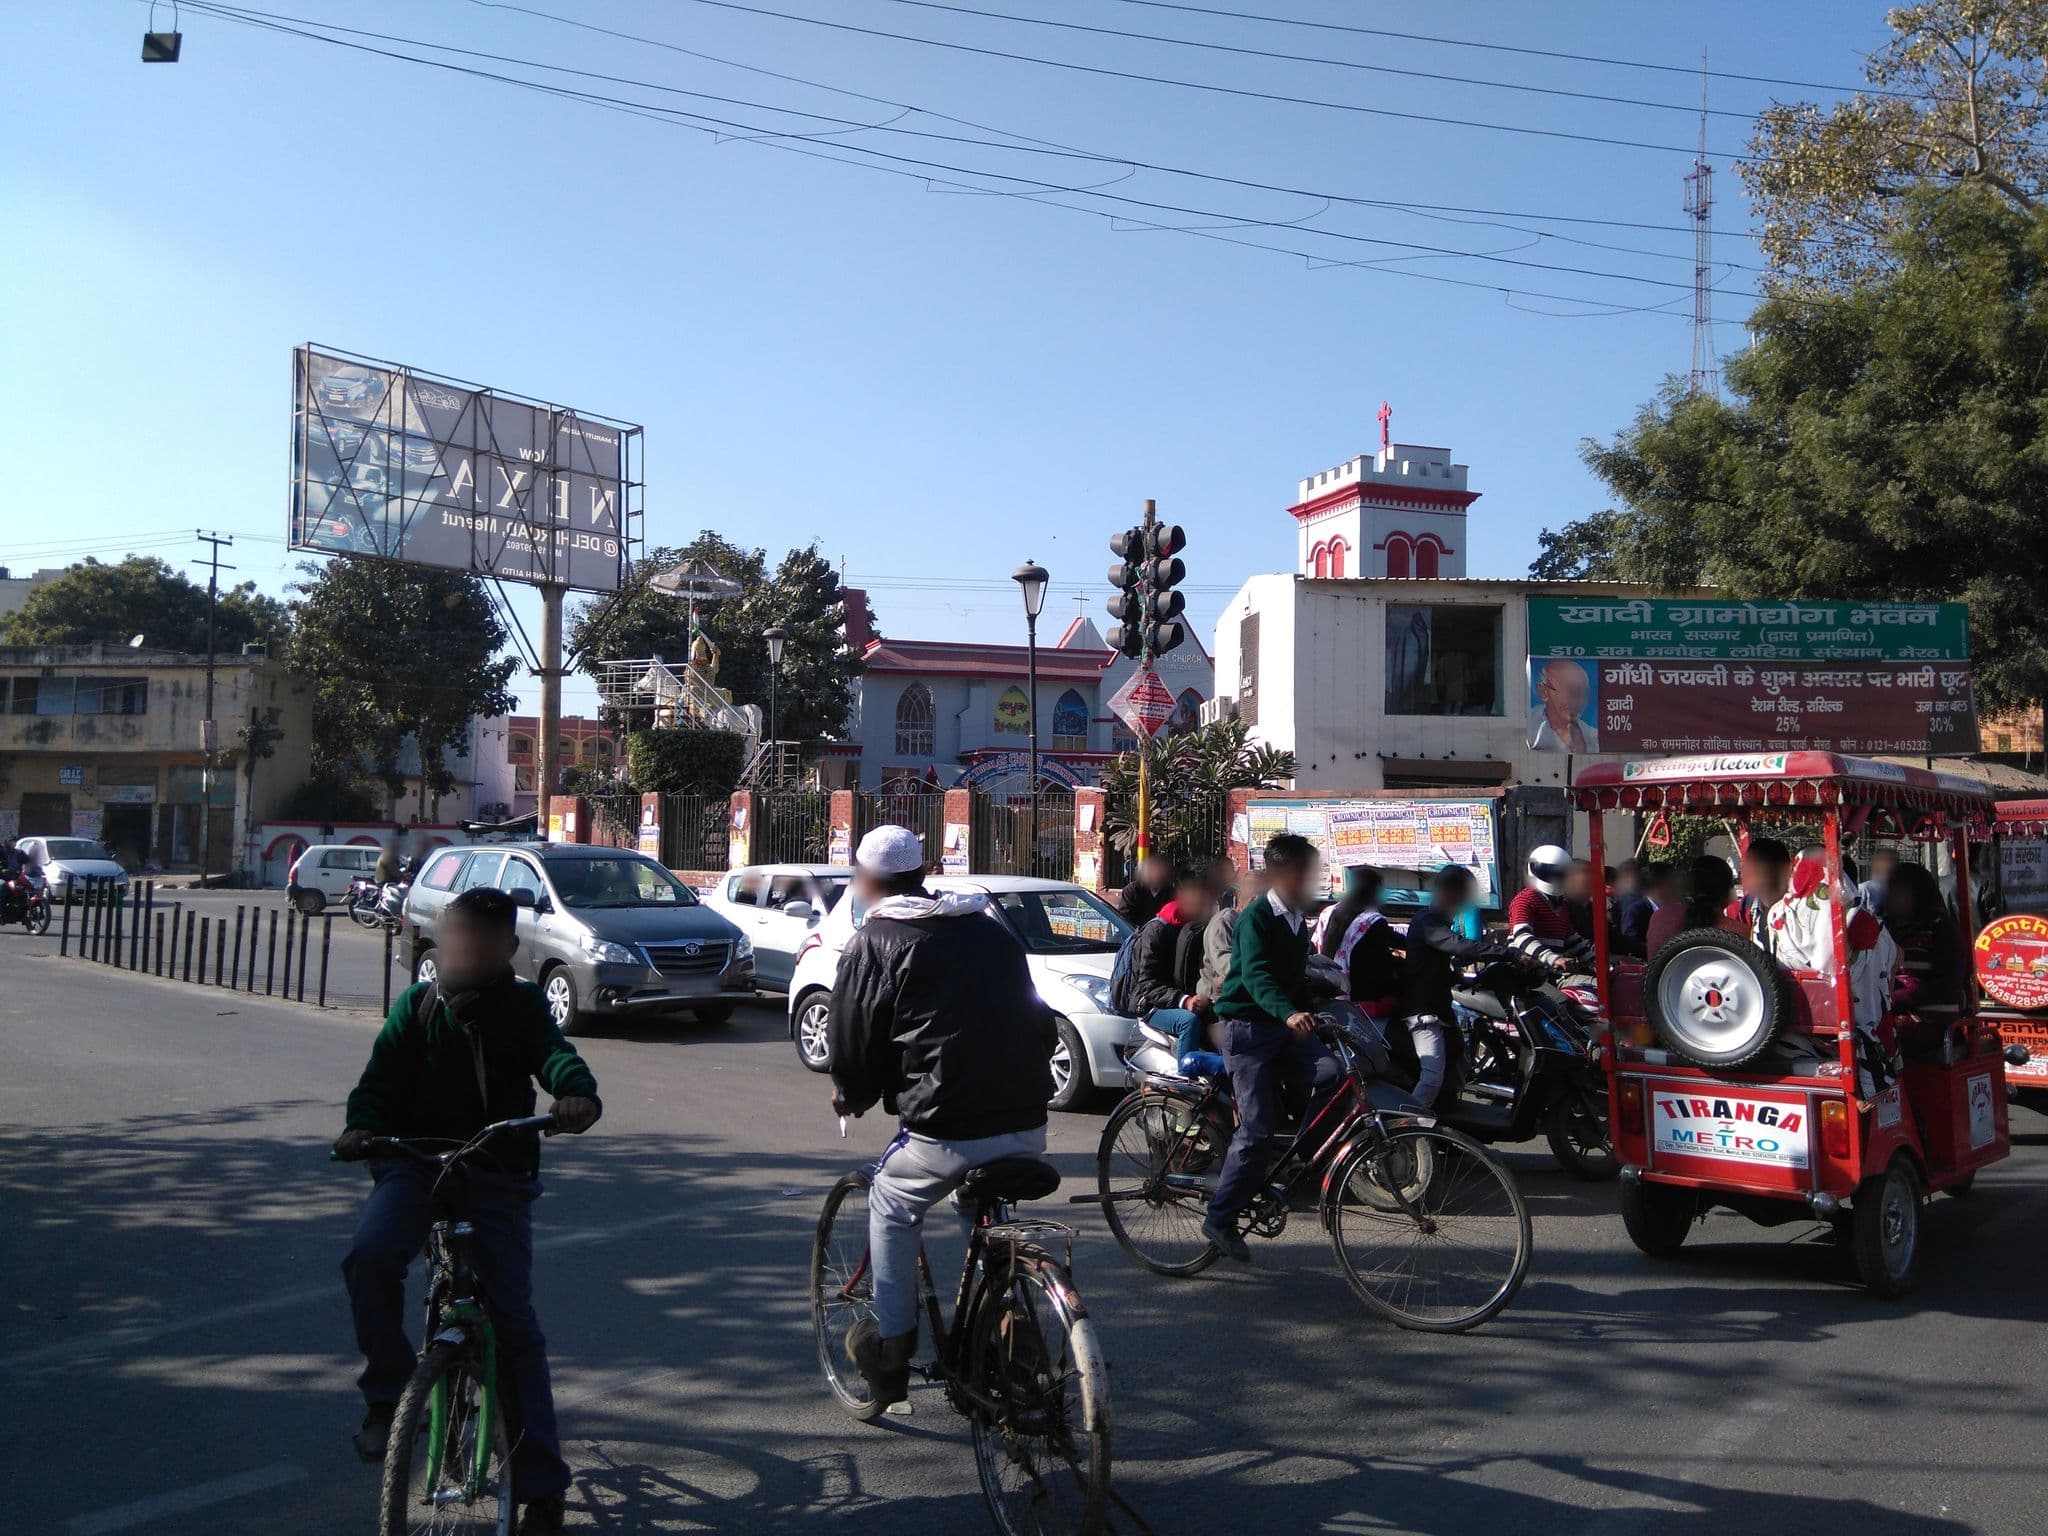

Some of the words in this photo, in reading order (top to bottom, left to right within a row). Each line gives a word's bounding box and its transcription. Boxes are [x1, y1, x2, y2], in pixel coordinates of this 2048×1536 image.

[1558, 600, 1655, 624] खादी
[1667, 602, 1838, 627] ग्रामोद्योग
[1850, 608, 1940, 626] भवन
[1631, 630, 1673, 641] भारत
[1684, 630, 1742, 641] सरकार
[1596, 646, 1633, 657] राम
[1645, 643, 1718, 658] मनोहर
[1728, 643, 1800, 658] लोहिया
[1658, 664, 1729, 687] जयन्ती
[1733, 665, 1756, 687] के
[1761, 671, 1797, 695] शुभ
[1801, 671, 1864, 688] अवसर
[1866, 671, 1893, 688] पर
[1897, 665, 1936, 688] भारी
[1606, 694, 1633, 711] खादी
[1606, 715, 1632, 732] 30%
[1776, 716, 1800, 732] 25%
[1929, 716, 1954, 733] 30%
[1661, 736, 1701, 750] राममनोहर
[1703, 735, 1731, 750] लोहिया
[1704, 756, 1761, 772] Metro
[1976, 918, 2048, 952] Panth
[1656, 1099, 1802, 1133] TIRANGA
[1672, 1128, 1780, 1152] METRO
